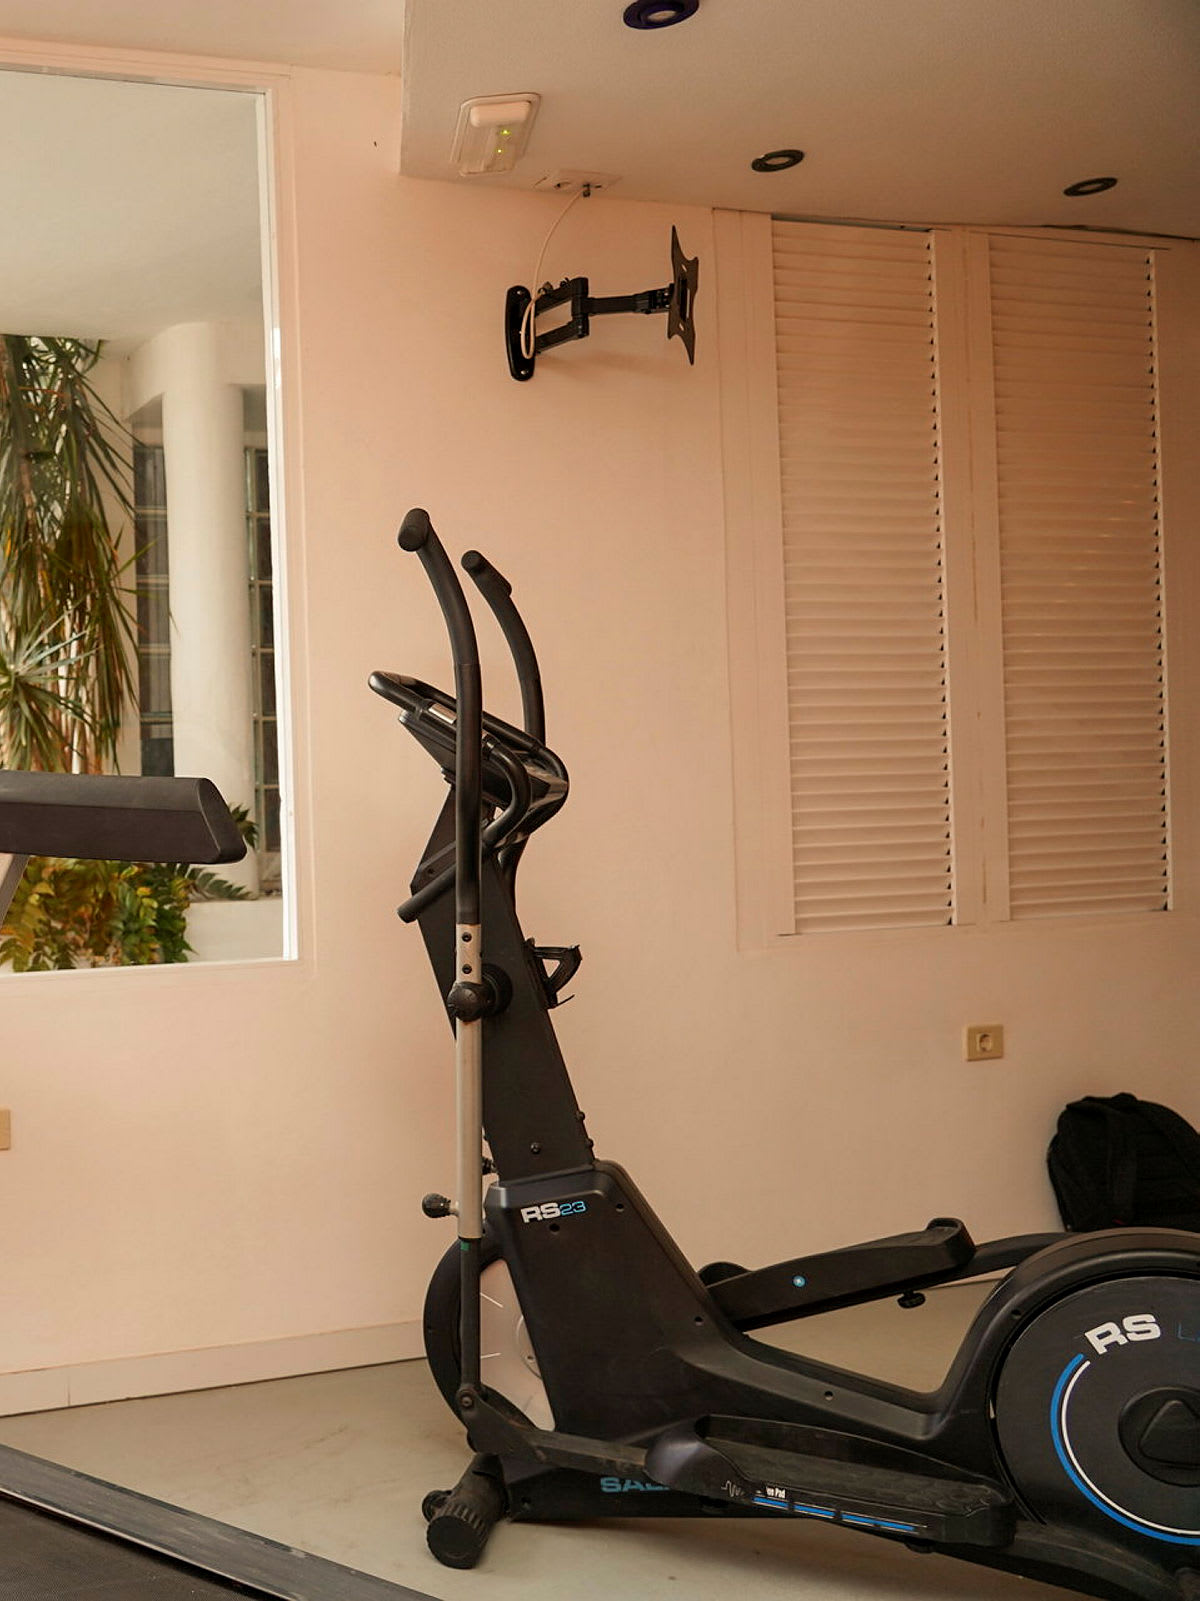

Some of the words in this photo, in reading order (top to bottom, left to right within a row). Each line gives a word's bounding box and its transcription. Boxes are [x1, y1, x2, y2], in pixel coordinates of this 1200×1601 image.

[520, 1201, 586, 1224] RS23
[1084, 1313, 1161, 1355] RS
[600, 1476, 670, 1493] SAL
